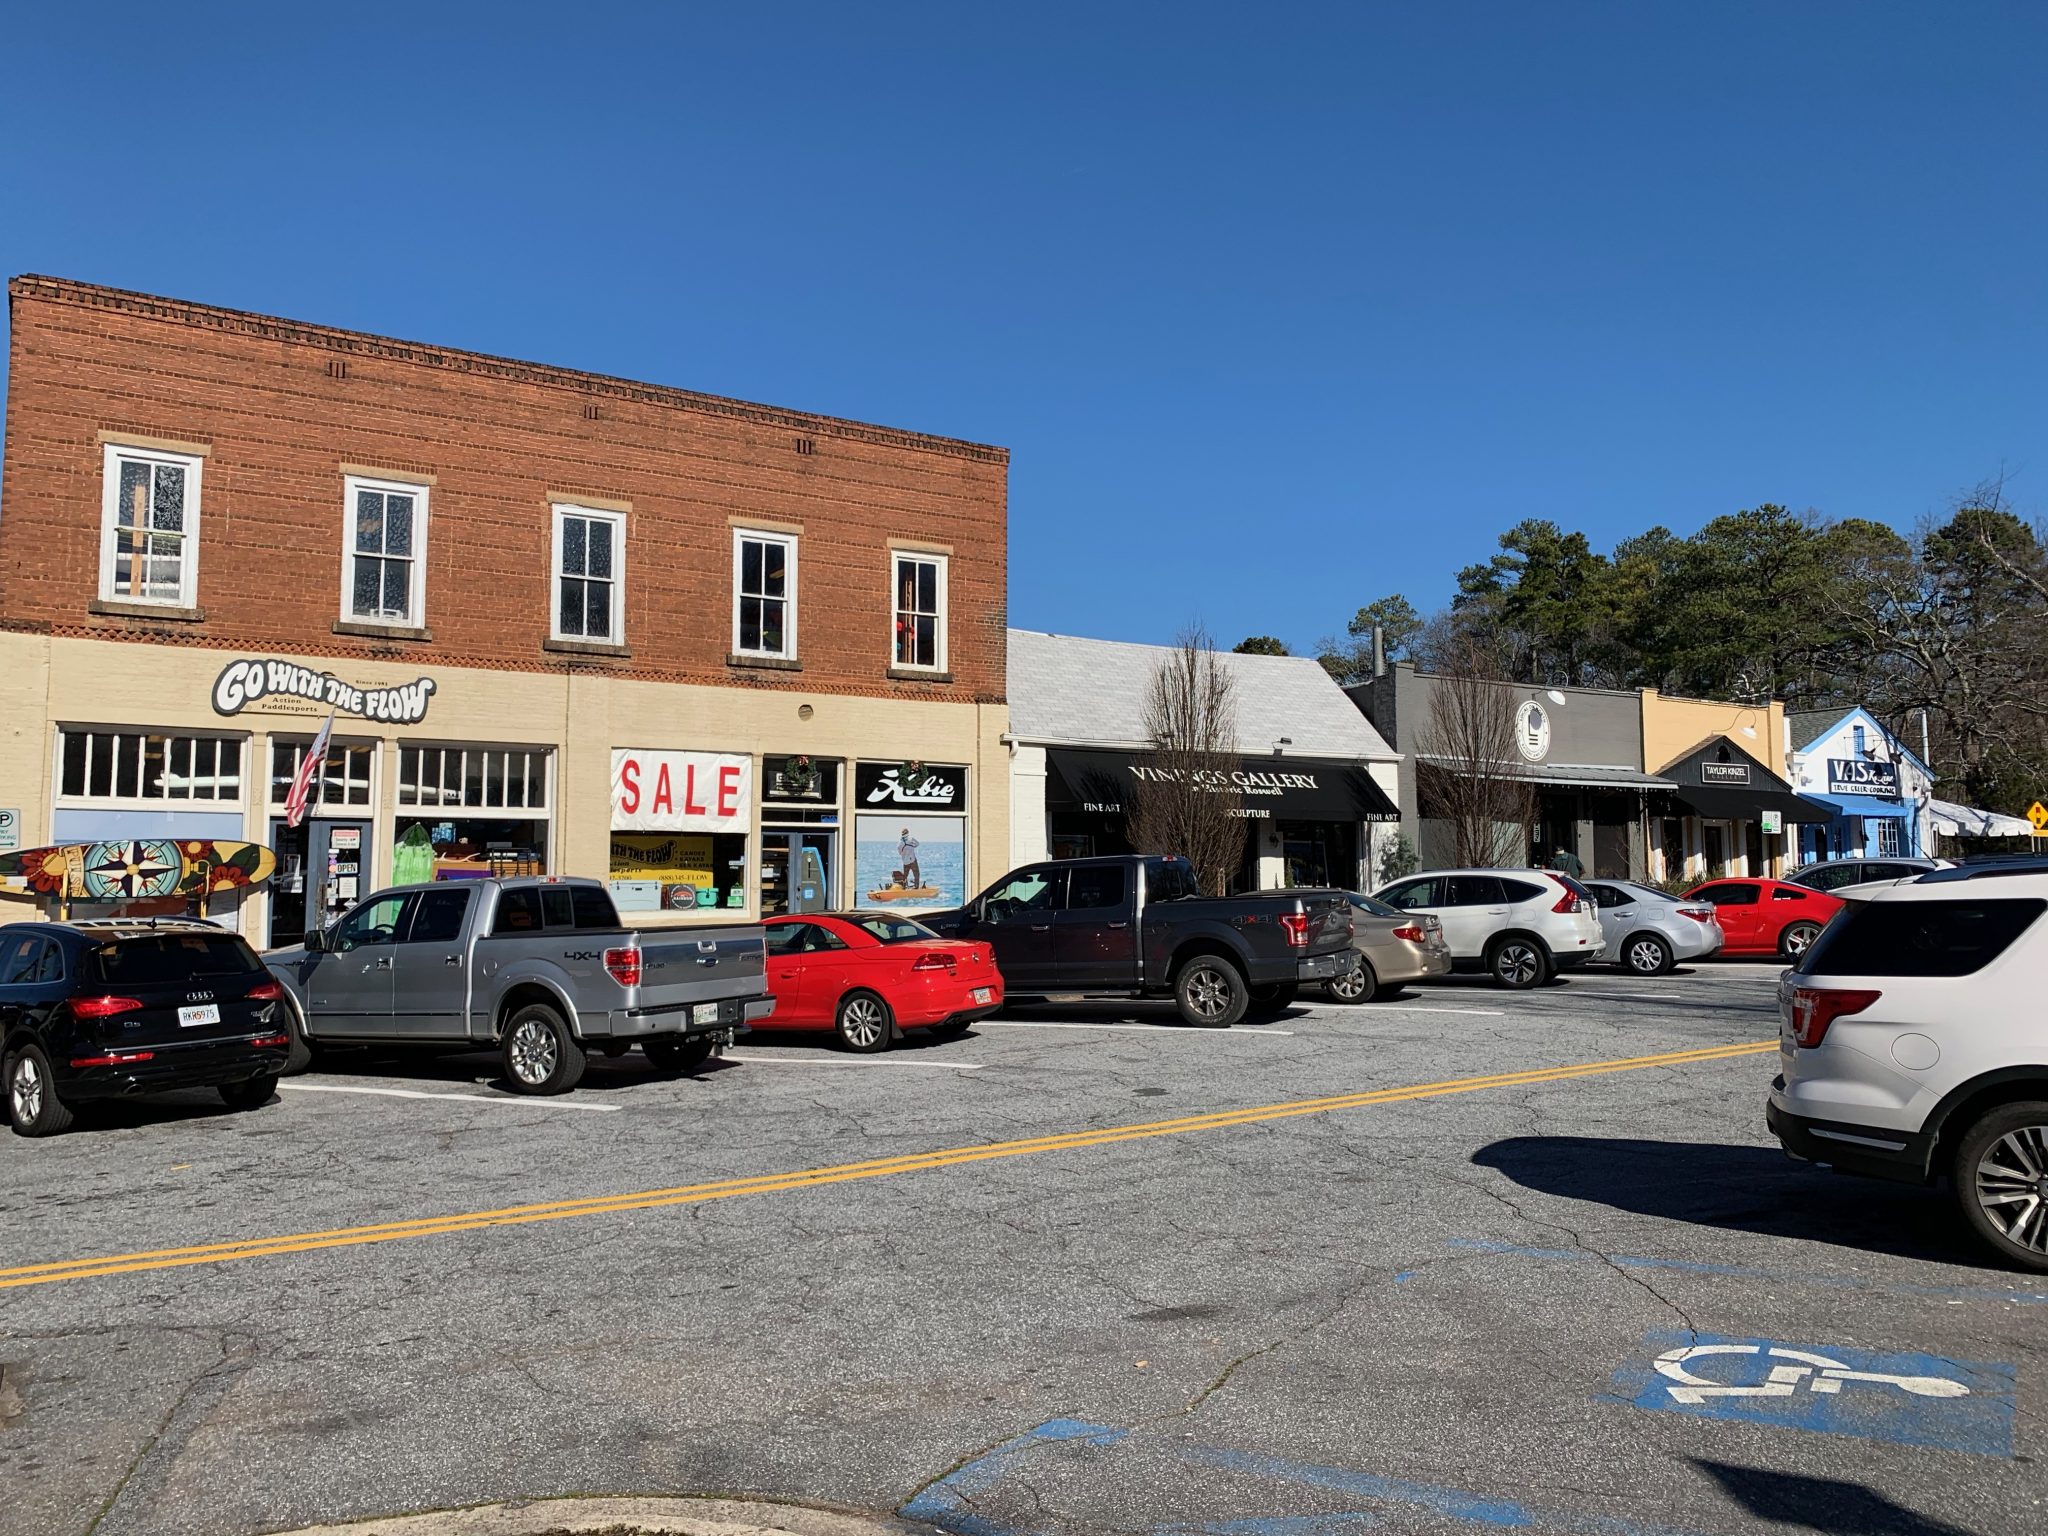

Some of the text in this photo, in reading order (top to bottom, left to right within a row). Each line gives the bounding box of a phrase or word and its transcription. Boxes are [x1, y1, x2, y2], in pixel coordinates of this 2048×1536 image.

[216, 661, 433, 720] GO WITH THE FLOW
[261, 703, 318, 712] Paddlesports
[1706, 766, 1746, 776] TAYLOR KINZEL
[1833, 760, 1868, 783] VAS
[1231, 771, 1319, 789] GALLERY
[621, 759, 740, 817] SALE
[1243, 786, 1284, 796] Roswell
[1833, 784, 1895, 795] TRUE GREEK COOKING
[1083, 802, 1120, 812] FINE ART
[1366, 813, 1398, 821] FINE ART
[645, 841, 675, 863] FLOW
[337, 863, 356, 873] OPEN
